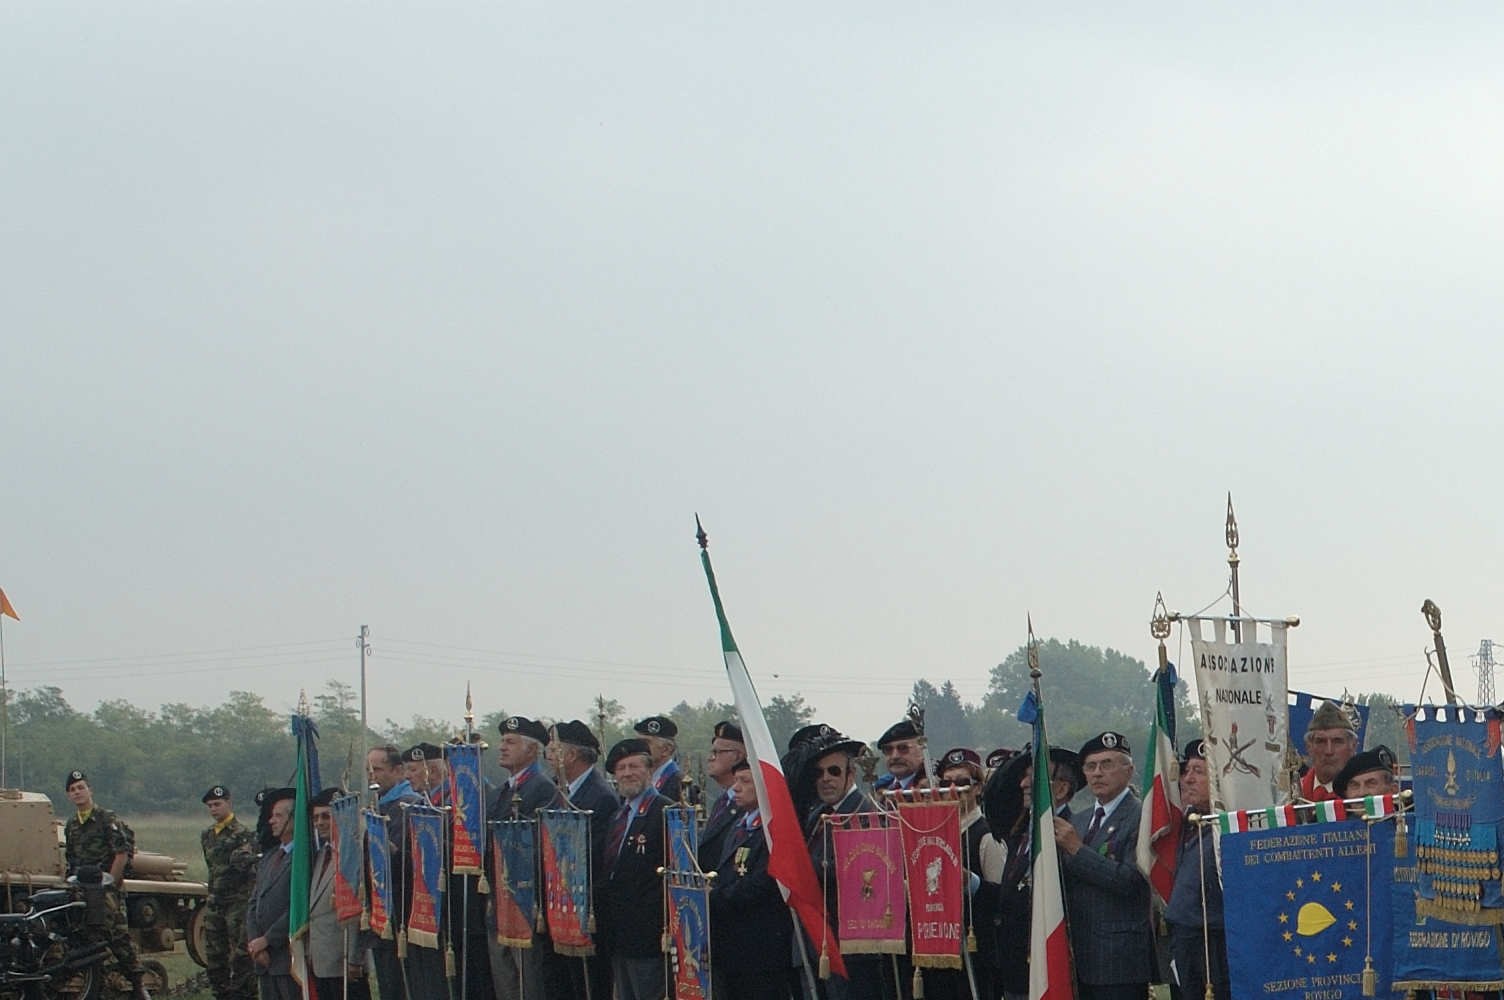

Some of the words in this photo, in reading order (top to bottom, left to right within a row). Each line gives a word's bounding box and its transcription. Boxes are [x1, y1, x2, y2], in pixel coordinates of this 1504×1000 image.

[1250, 834, 1318, 850] FEDERAZIONE
[1244, 854, 1260, 866] DEI
[1264, 847, 1334, 863] COMBATTENTI
[1263, 977, 1308, 993] SEZIONE
[1311, 973, 1380, 988] PROVINCIE
